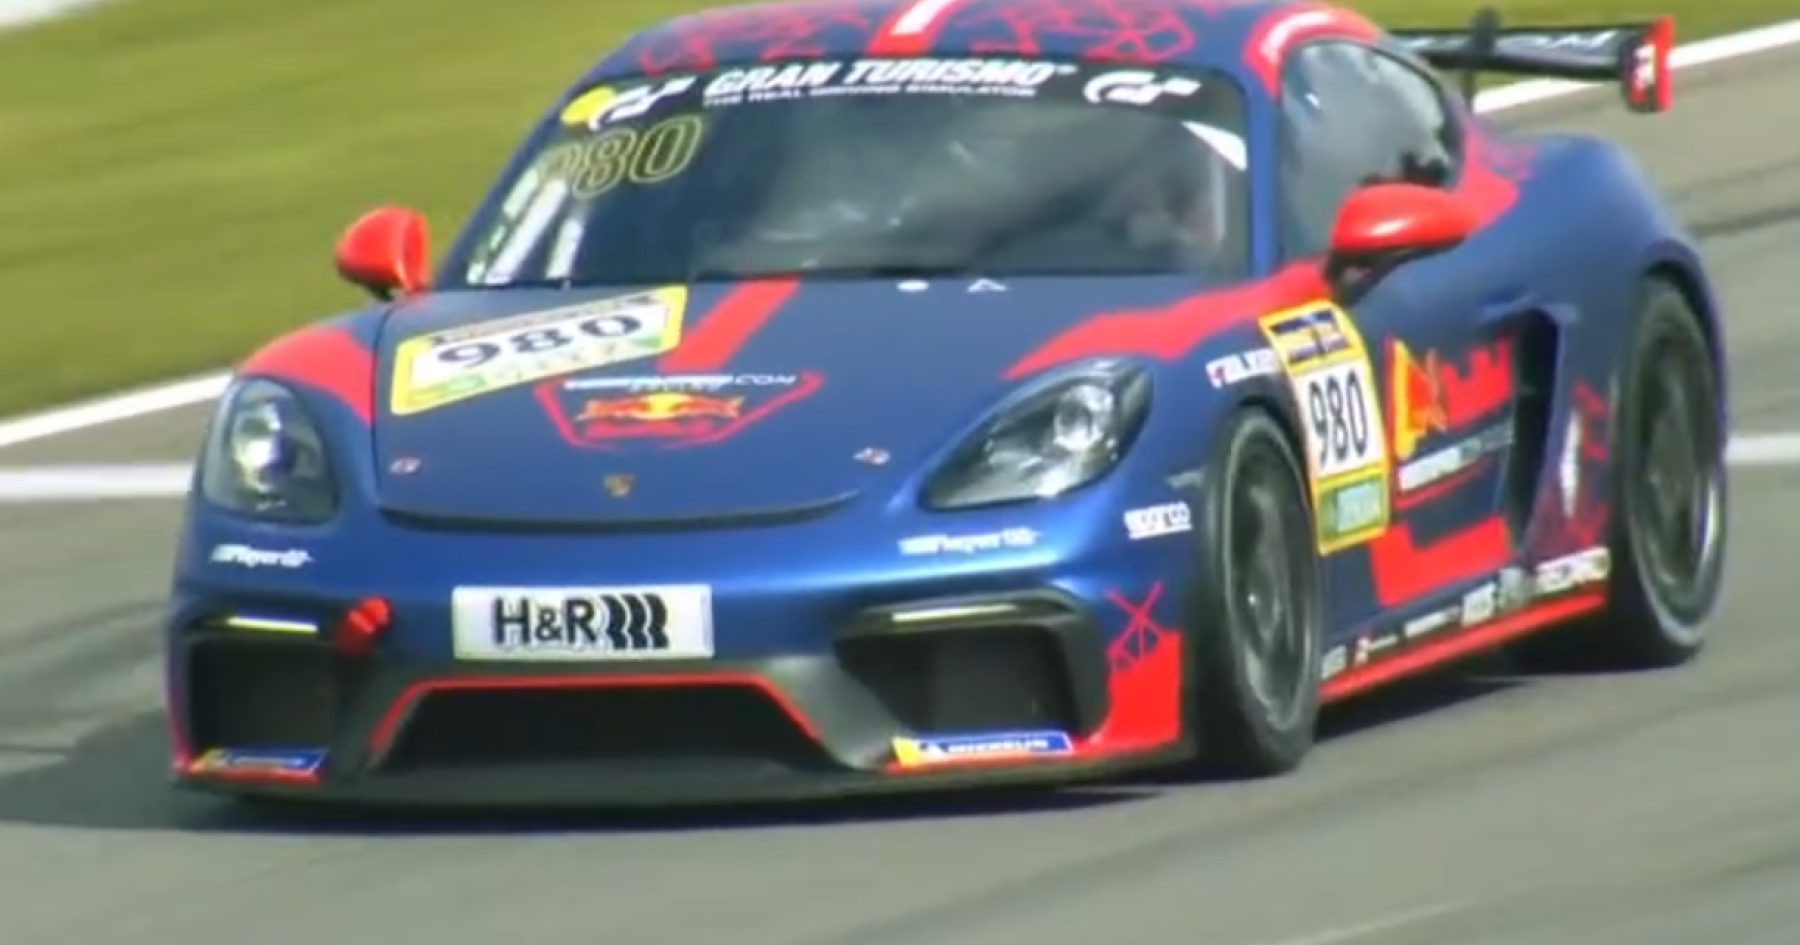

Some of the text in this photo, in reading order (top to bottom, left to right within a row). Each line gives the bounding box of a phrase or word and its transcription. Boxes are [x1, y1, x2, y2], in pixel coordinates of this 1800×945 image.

[703, 58, 1055, 97] GRAN TURISMO
[436, 313, 643, 368] 980
[1307, 368, 1368, 471] 980
[493, 594, 598, 646] H&R
